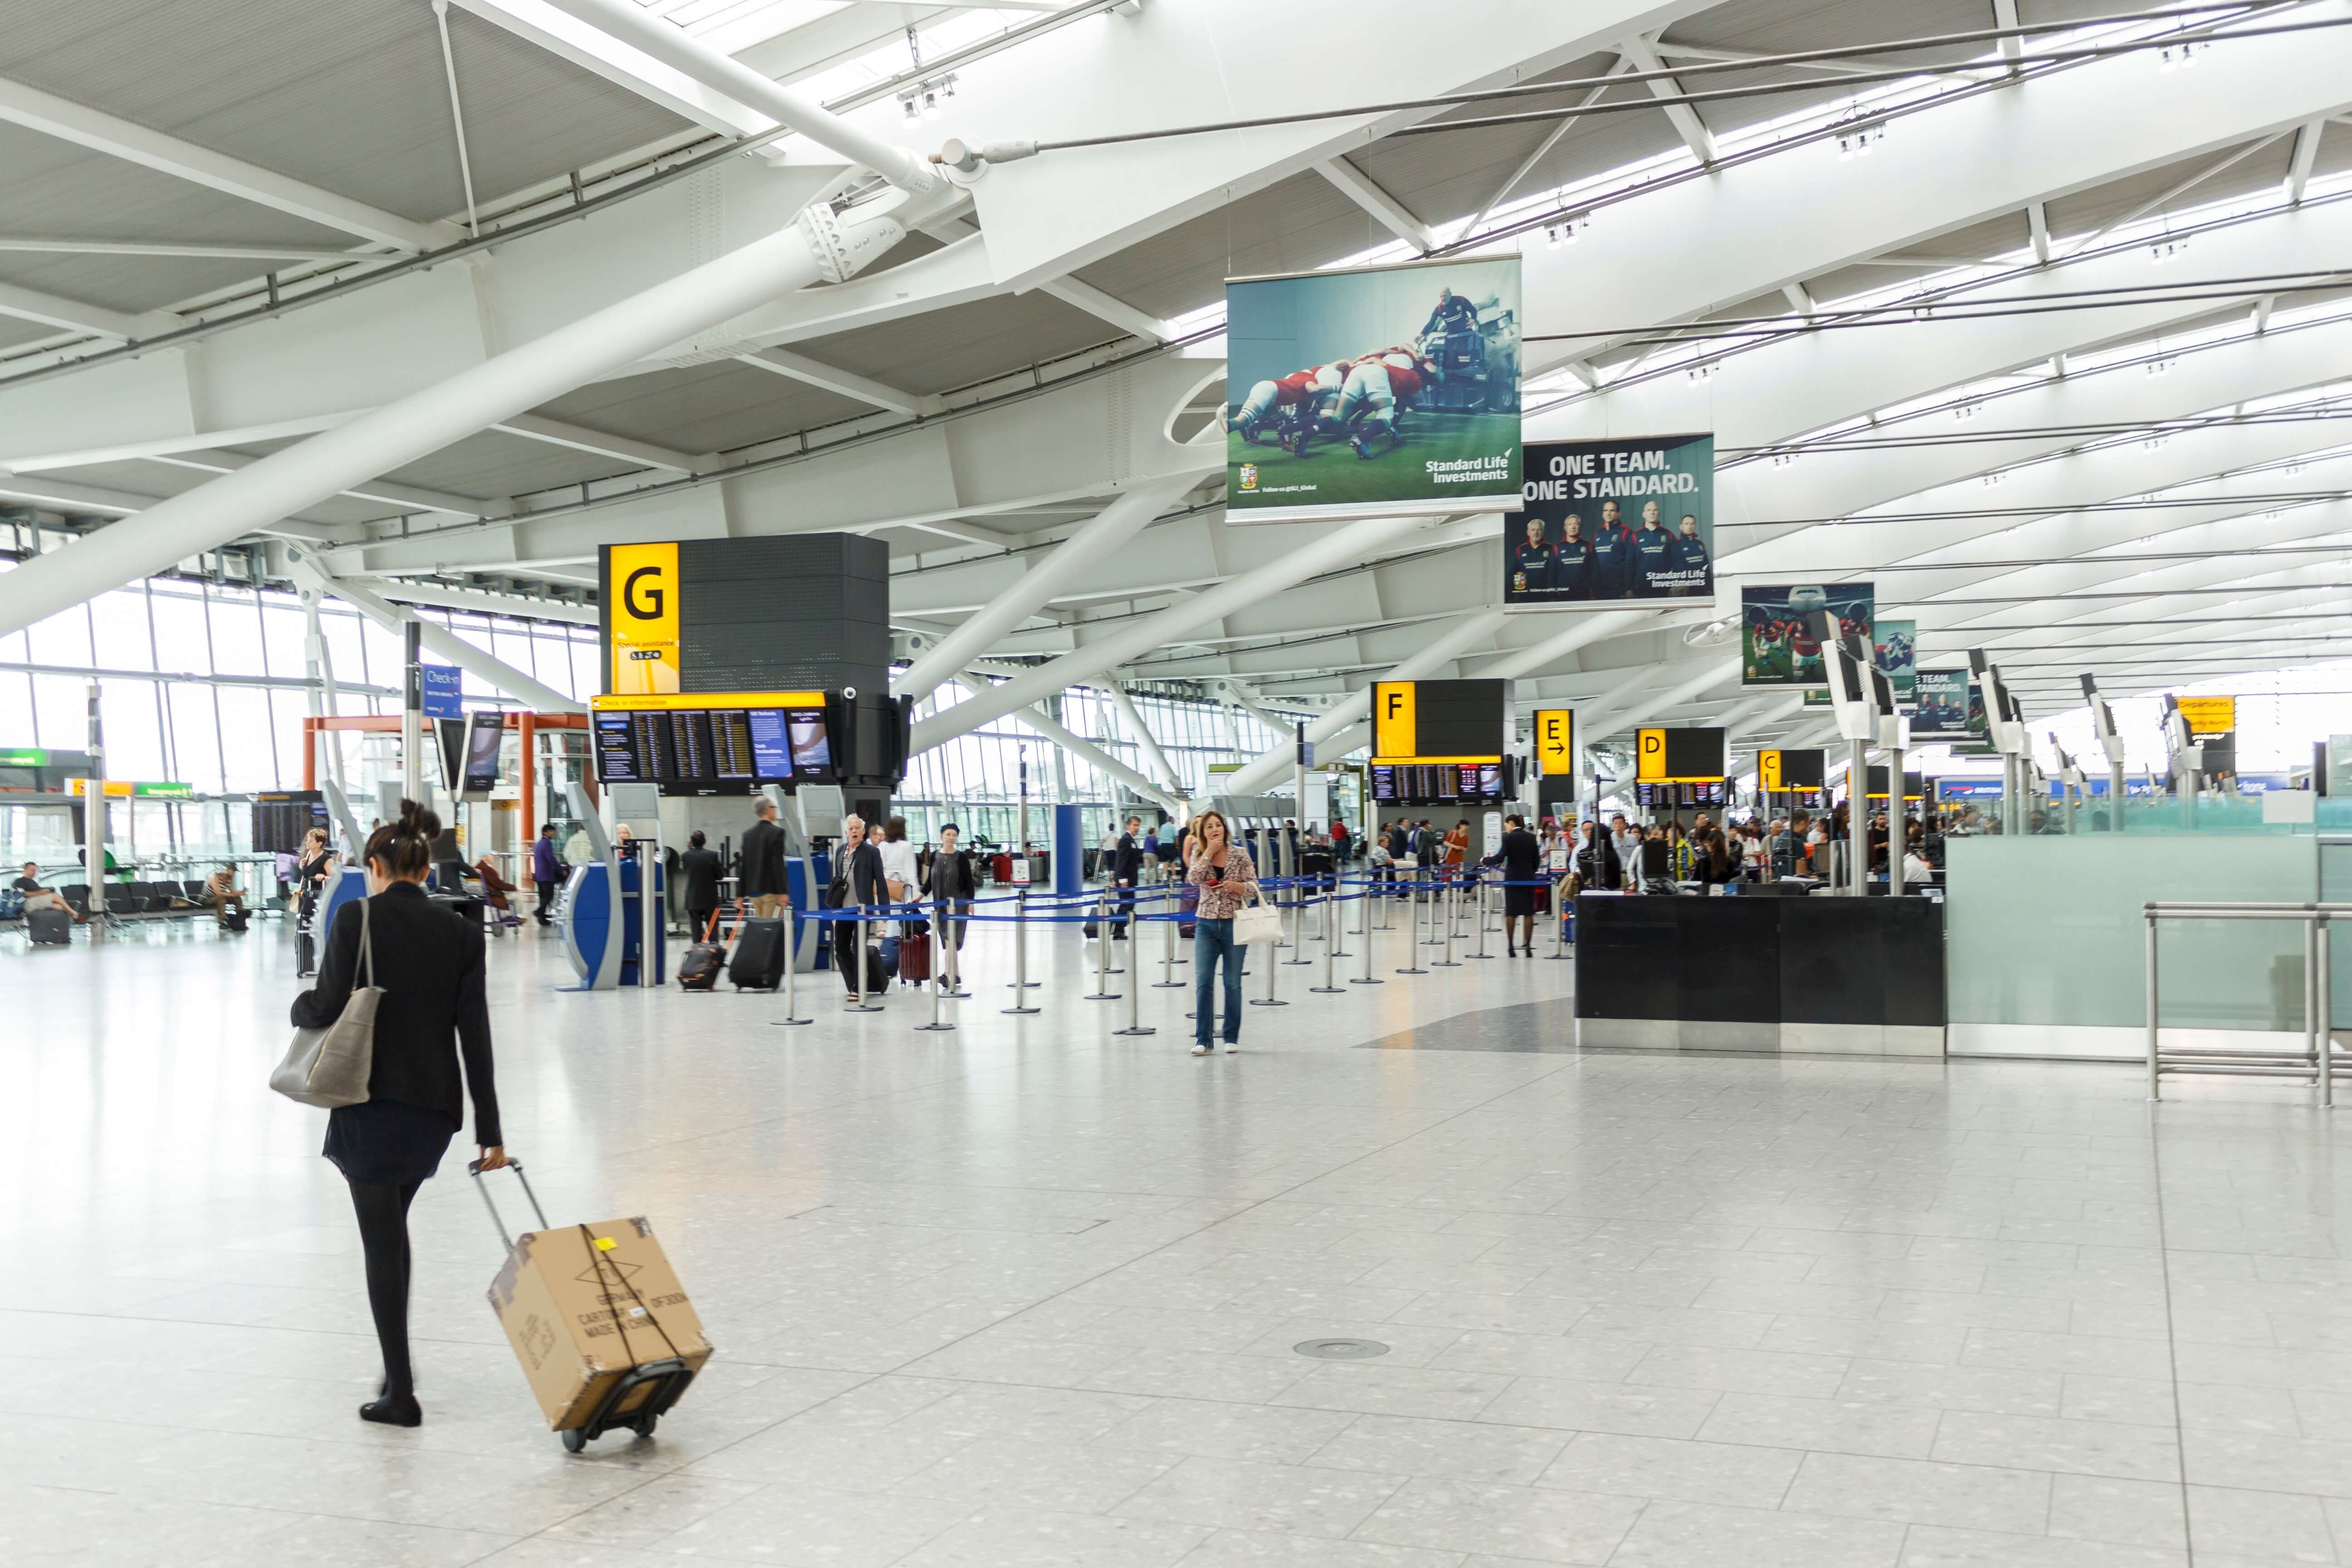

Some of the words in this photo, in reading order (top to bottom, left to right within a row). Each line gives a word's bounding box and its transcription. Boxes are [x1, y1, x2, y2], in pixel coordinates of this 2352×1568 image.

[1426, 458, 1482, 472] Standard
[1484, 456, 1508, 469] Life
[1549, 455, 1595, 476] ONE
[1600, 451, 1671, 473] TEAM.
[1434, 470, 1509, 483] Investments
[1523, 480, 1568, 501] ONE
[1573, 473, 1699, 499] STANDARD.
[1646, 570, 1686, 581] Standard
[1688, 569, 1705, 578] Life
[1651, 578, 1706, 588] Investments
[624, 567, 663, 620] G
[427, 671, 459, 684] Check-in
[1915, 683, 1963, 693] TANDARD.
[1388, 694, 1402, 720] F
[1548, 720, 1559, 740] E
[1646, 736, 1660, 753] D
[1765, 756, 1776, 769] C
